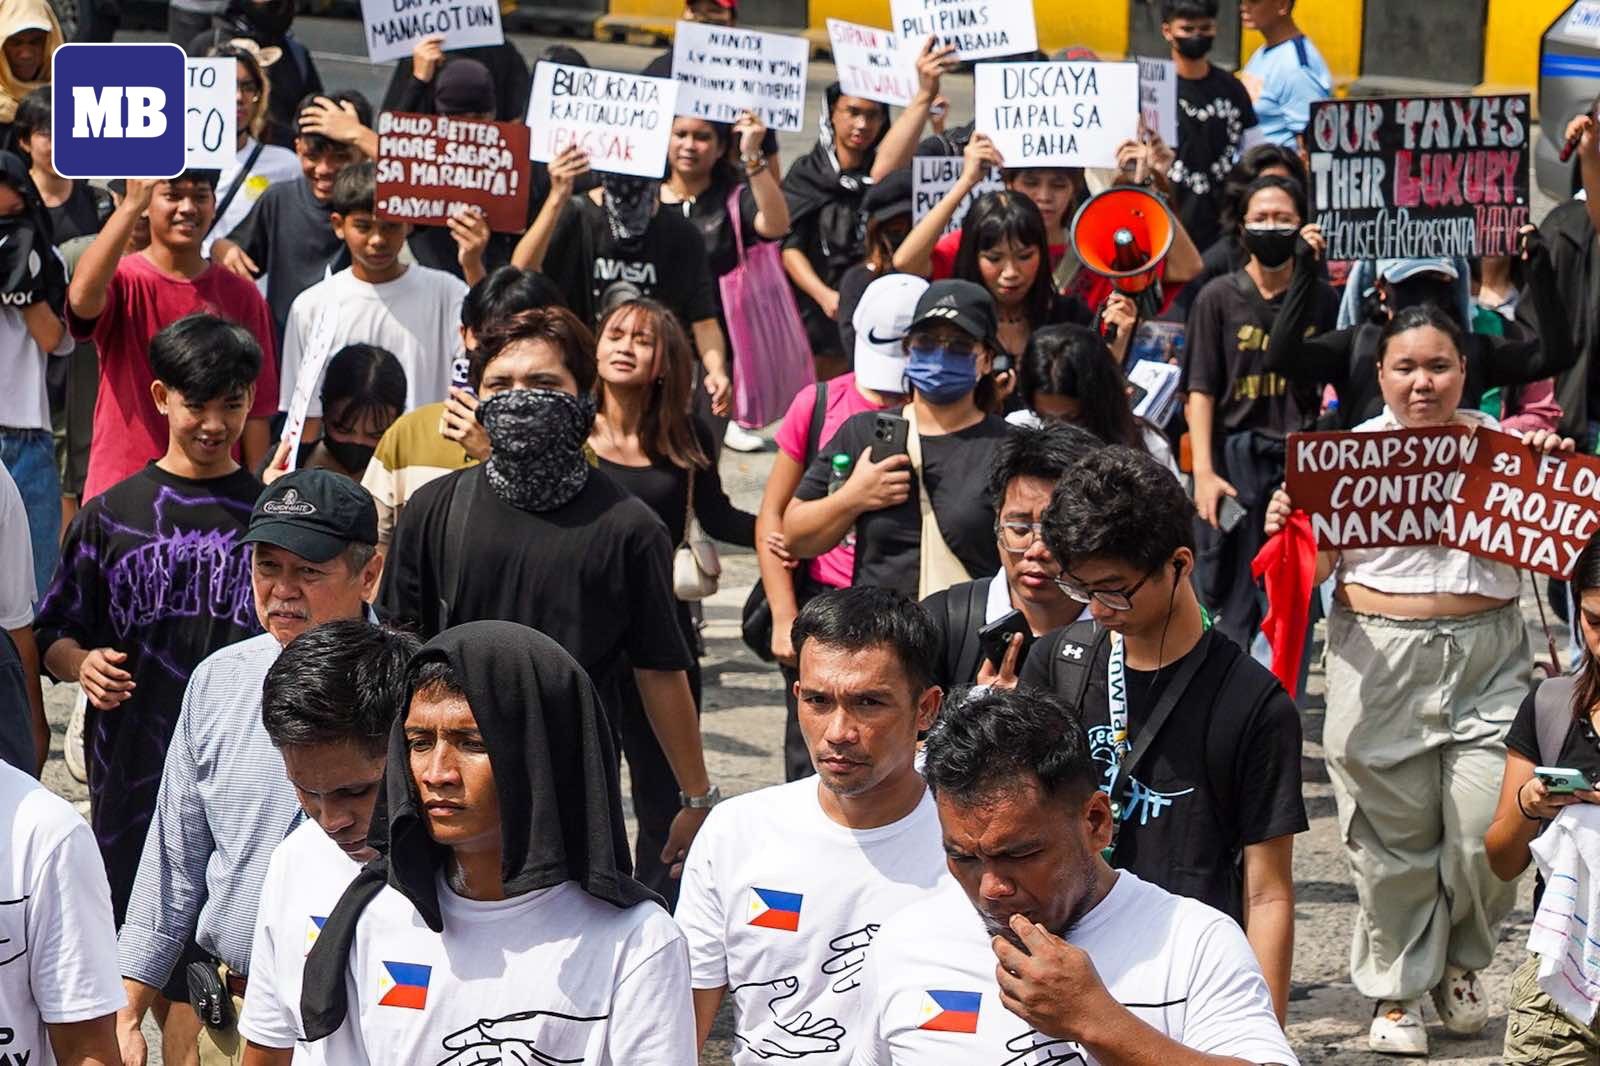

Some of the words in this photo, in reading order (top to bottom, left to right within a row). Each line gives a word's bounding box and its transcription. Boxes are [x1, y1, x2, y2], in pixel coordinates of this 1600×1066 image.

[372, 7, 461, 47] MANAGOT
[467, 6, 494, 27] DIN
[902, 6, 989, 39] PILIPINAS
[1003, 66, 1099, 99] DISCAYA
[550, 101, 658, 130] KAPITALISMO
[995, 104, 1065, 130] ITAPAL
[1071, 102, 1103, 128] SA
[1314, 99, 1384, 152] OUR
[1022, 133, 1079, 158] BAHA
[376, 158, 405, 183] SA
[410, 162, 519, 196] MARALITA!
[1310, 152, 1386, 210] THEIR
[1393, 149, 1524, 208] LUXURY.
[593, 257, 657, 284] NASA
[1297, 435, 1479, 472] KORAPSYON
[1484, 481, 1600, 541] PROJEC
[1311, 504, 1585, 577] NAKAMAMATAY
